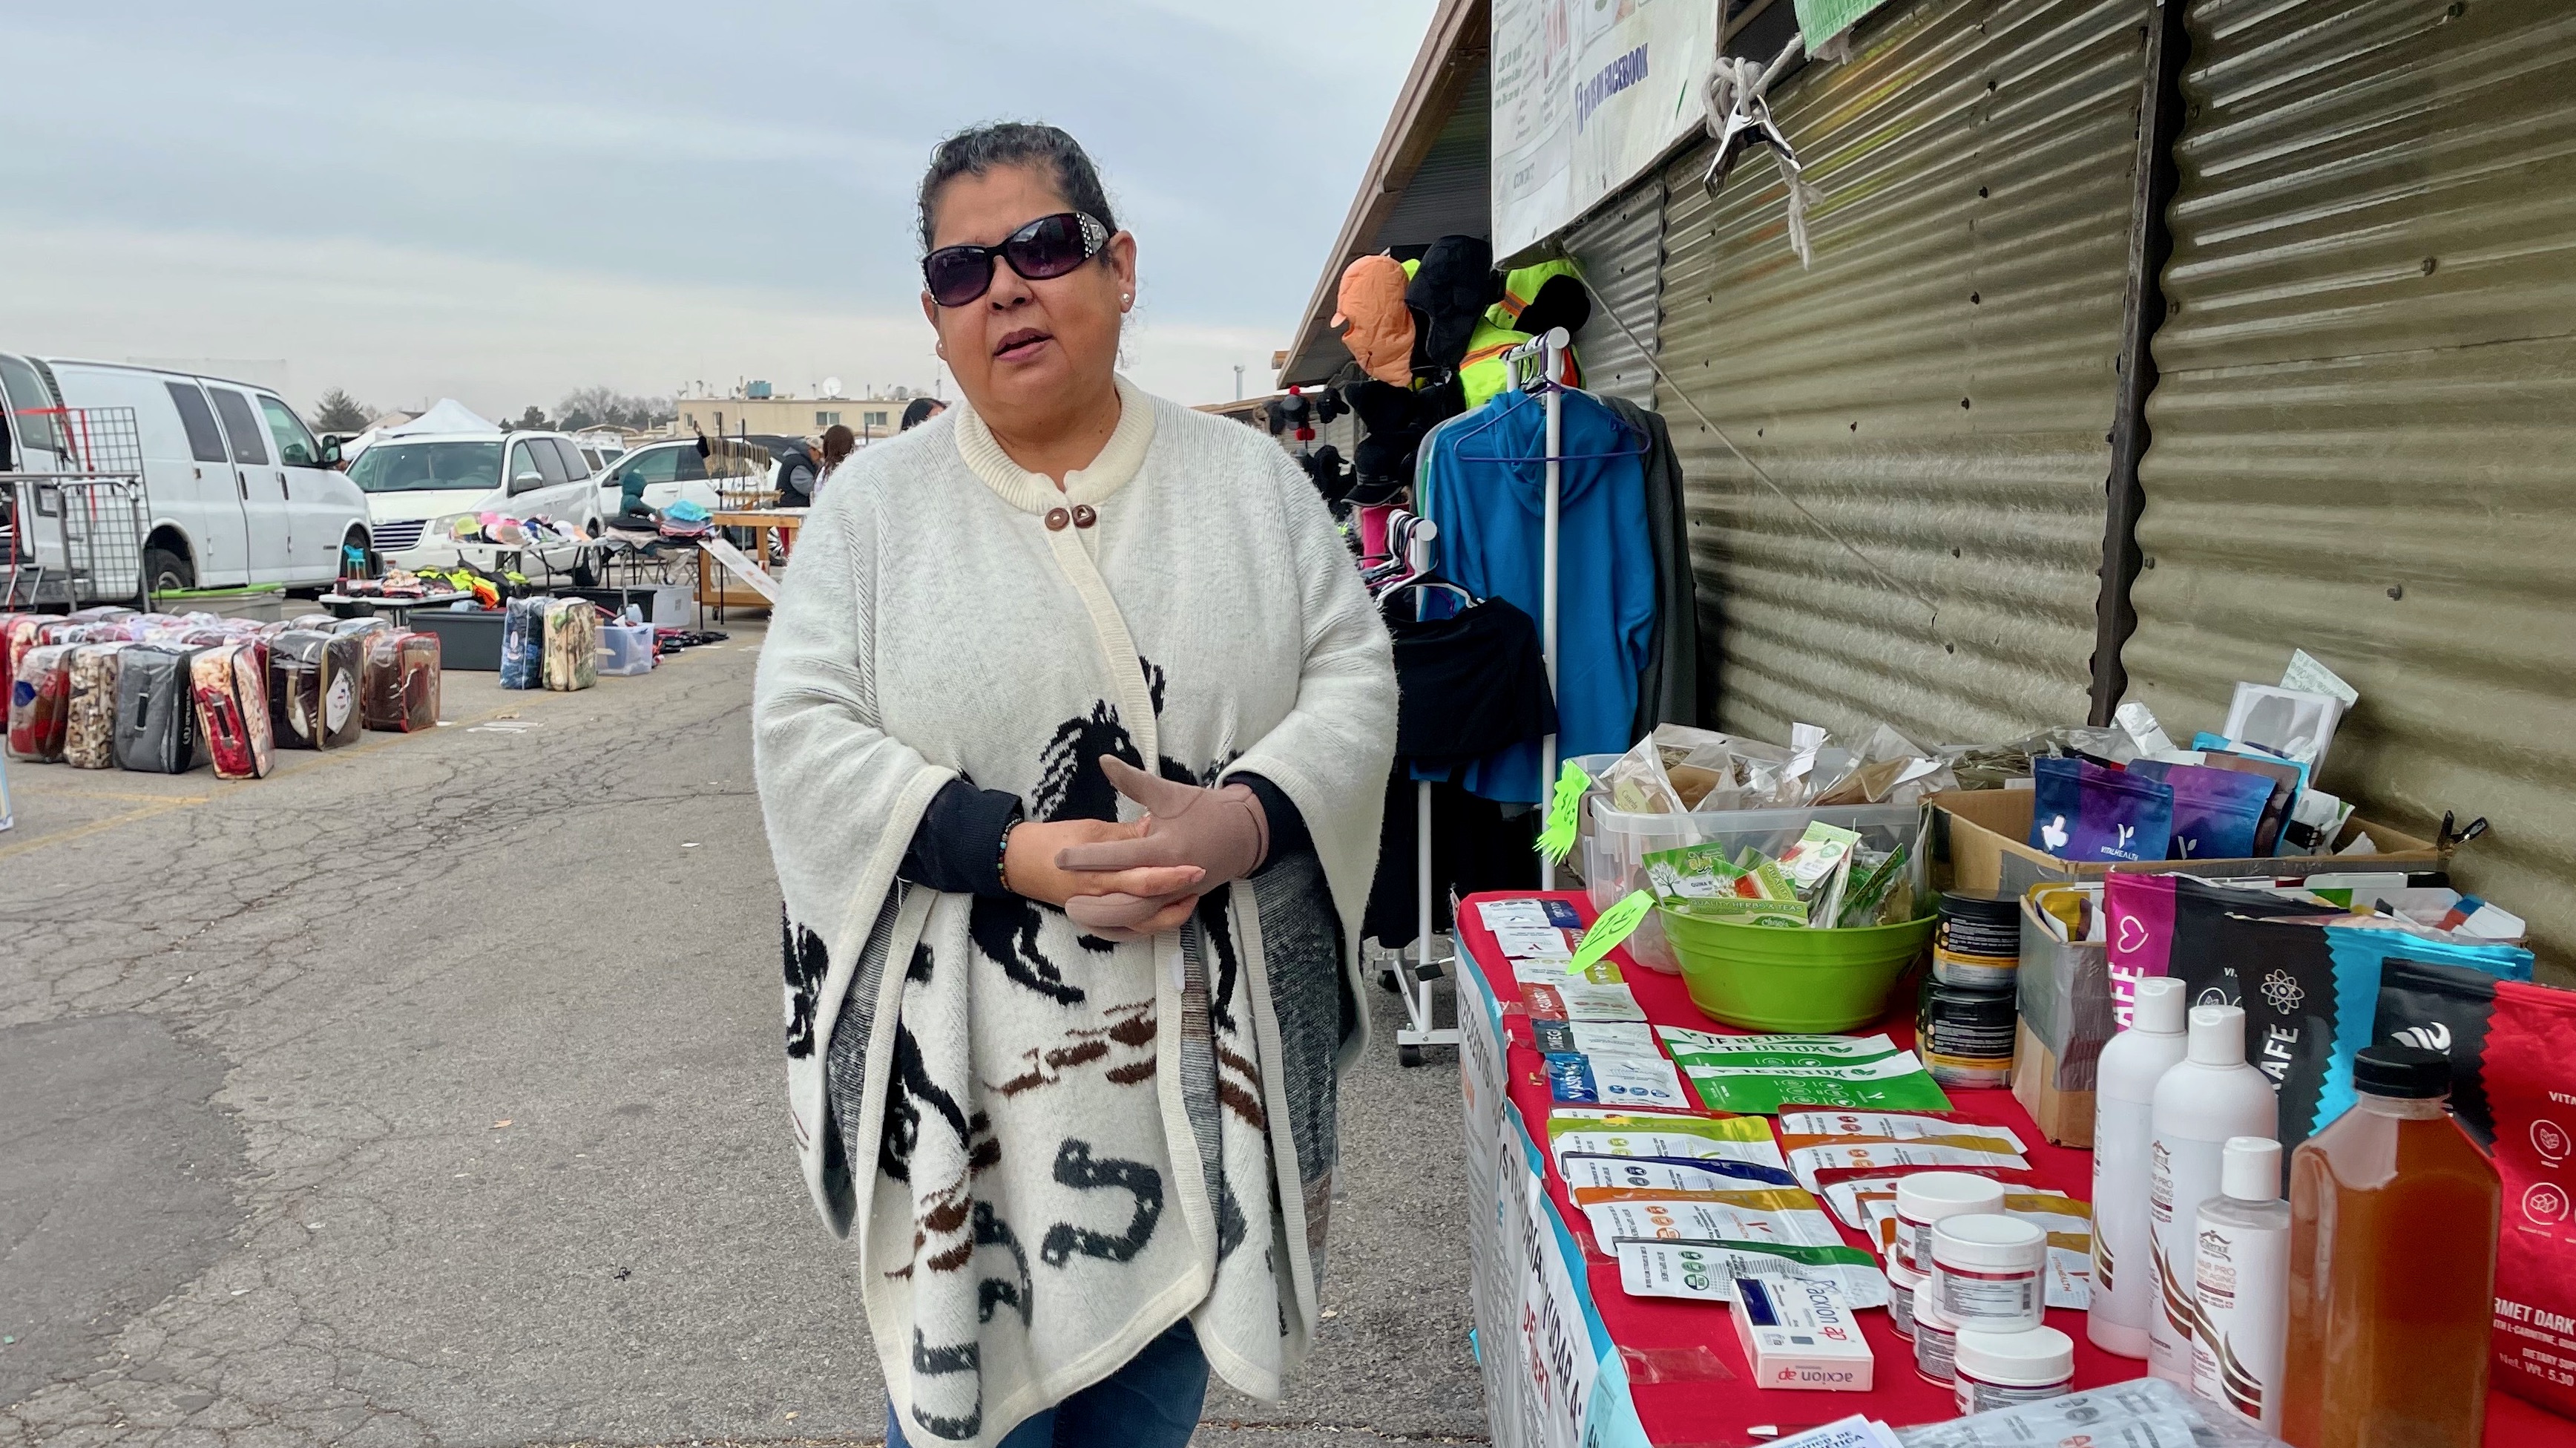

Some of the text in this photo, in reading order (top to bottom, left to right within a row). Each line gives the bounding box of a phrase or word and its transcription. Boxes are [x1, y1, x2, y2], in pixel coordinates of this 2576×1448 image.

[1604, 42, 1649, 99] FACEBOOK
[2101, 845, 2139, 861] VITALHEALTH
[1767, 865, 1792, 900] QUALITY
[1690, 899, 1804, 913] QUALITY HERBS & TEAS
[1753, 1045, 1826, 1053] DETOX
[1806, 1285, 1847, 1341] acxion ap
[2534, 1308, 2576, 1336] DARK
[1778, 1367, 1853, 1386] acxion ap
